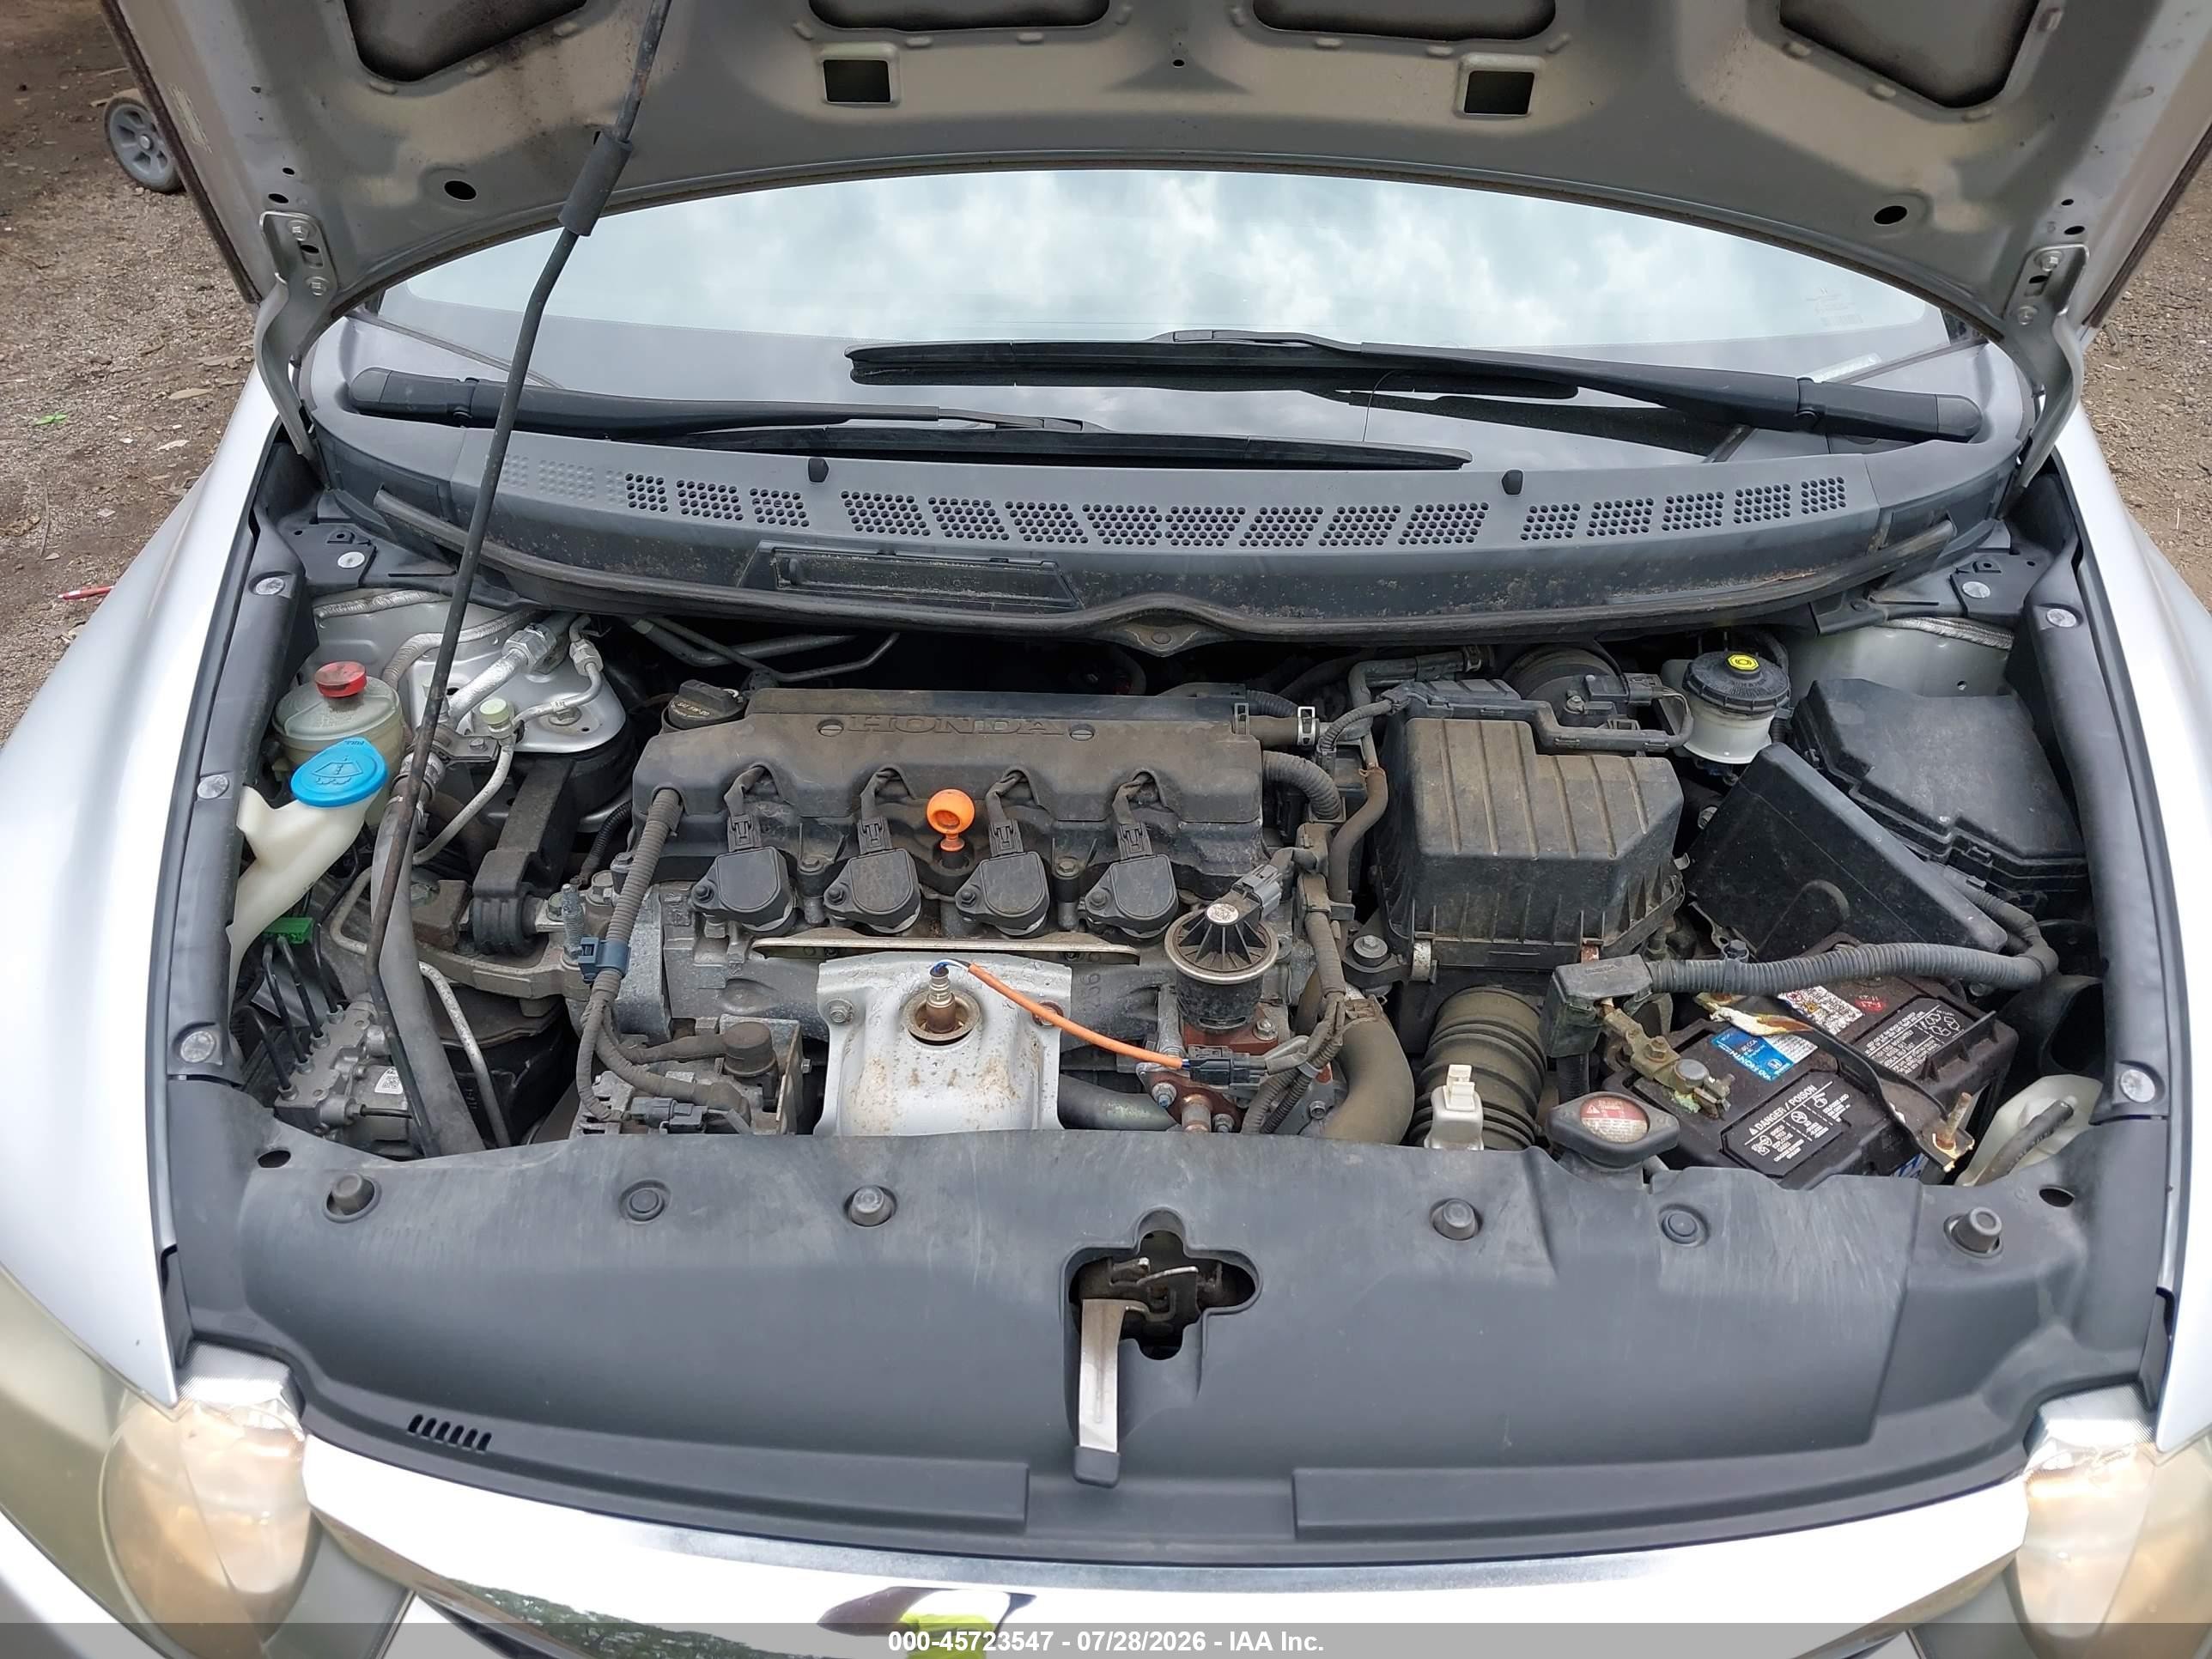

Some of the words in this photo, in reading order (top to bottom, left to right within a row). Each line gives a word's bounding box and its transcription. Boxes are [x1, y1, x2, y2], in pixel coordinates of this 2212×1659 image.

[850, 715, 1064, 735] HONDA
[1754, 1106, 1788, 1131] DANGER
[1788, 1084, 1818, 1107] POISON
